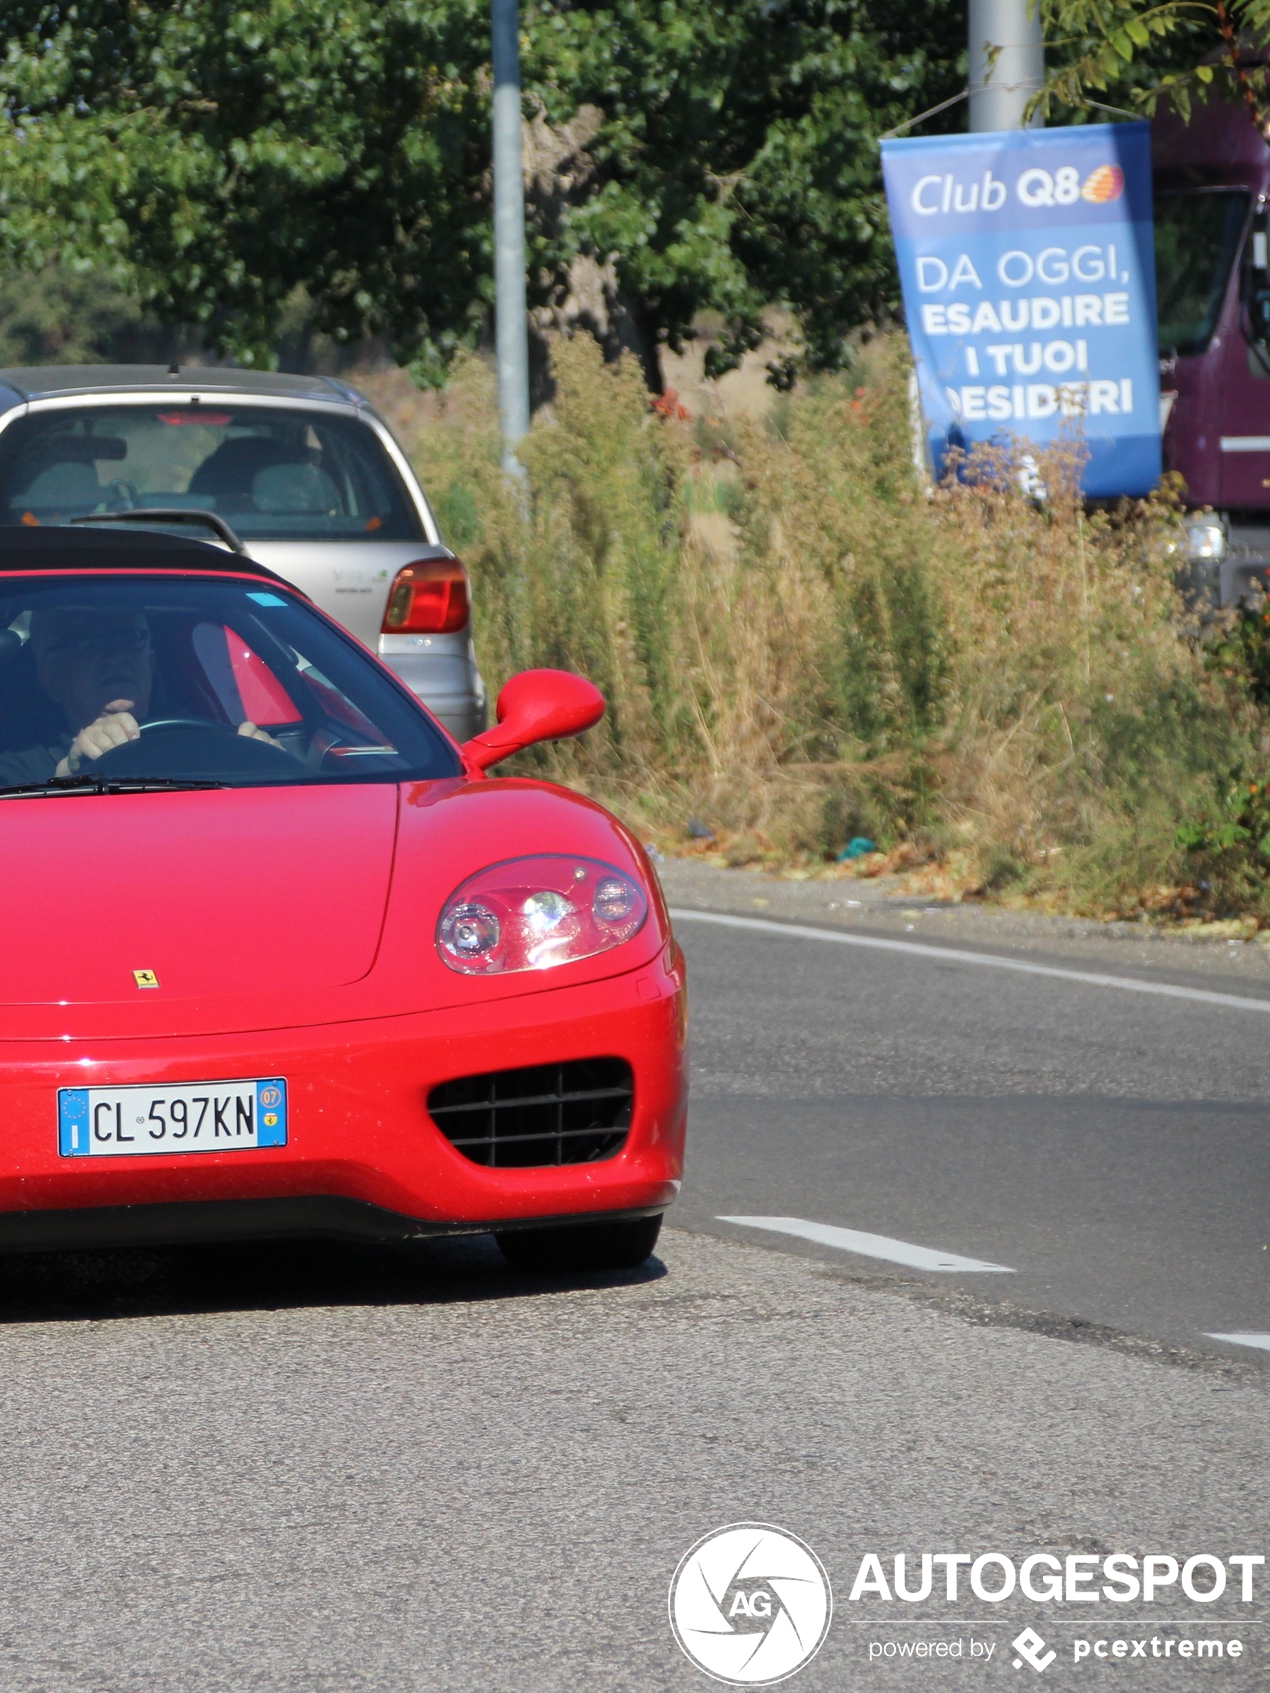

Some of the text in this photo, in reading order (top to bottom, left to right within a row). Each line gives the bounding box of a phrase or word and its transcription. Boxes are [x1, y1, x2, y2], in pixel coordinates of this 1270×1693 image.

[911, 165, 1081, 217] Club Q8
[916, 244, 1130, 293] DA OGGI,
[922, 292, 1130, 336] ESAUDIRE
[966, 339, 1088, 377] I TUOI
[94, 1094, 254, 1142] CL 597KN
